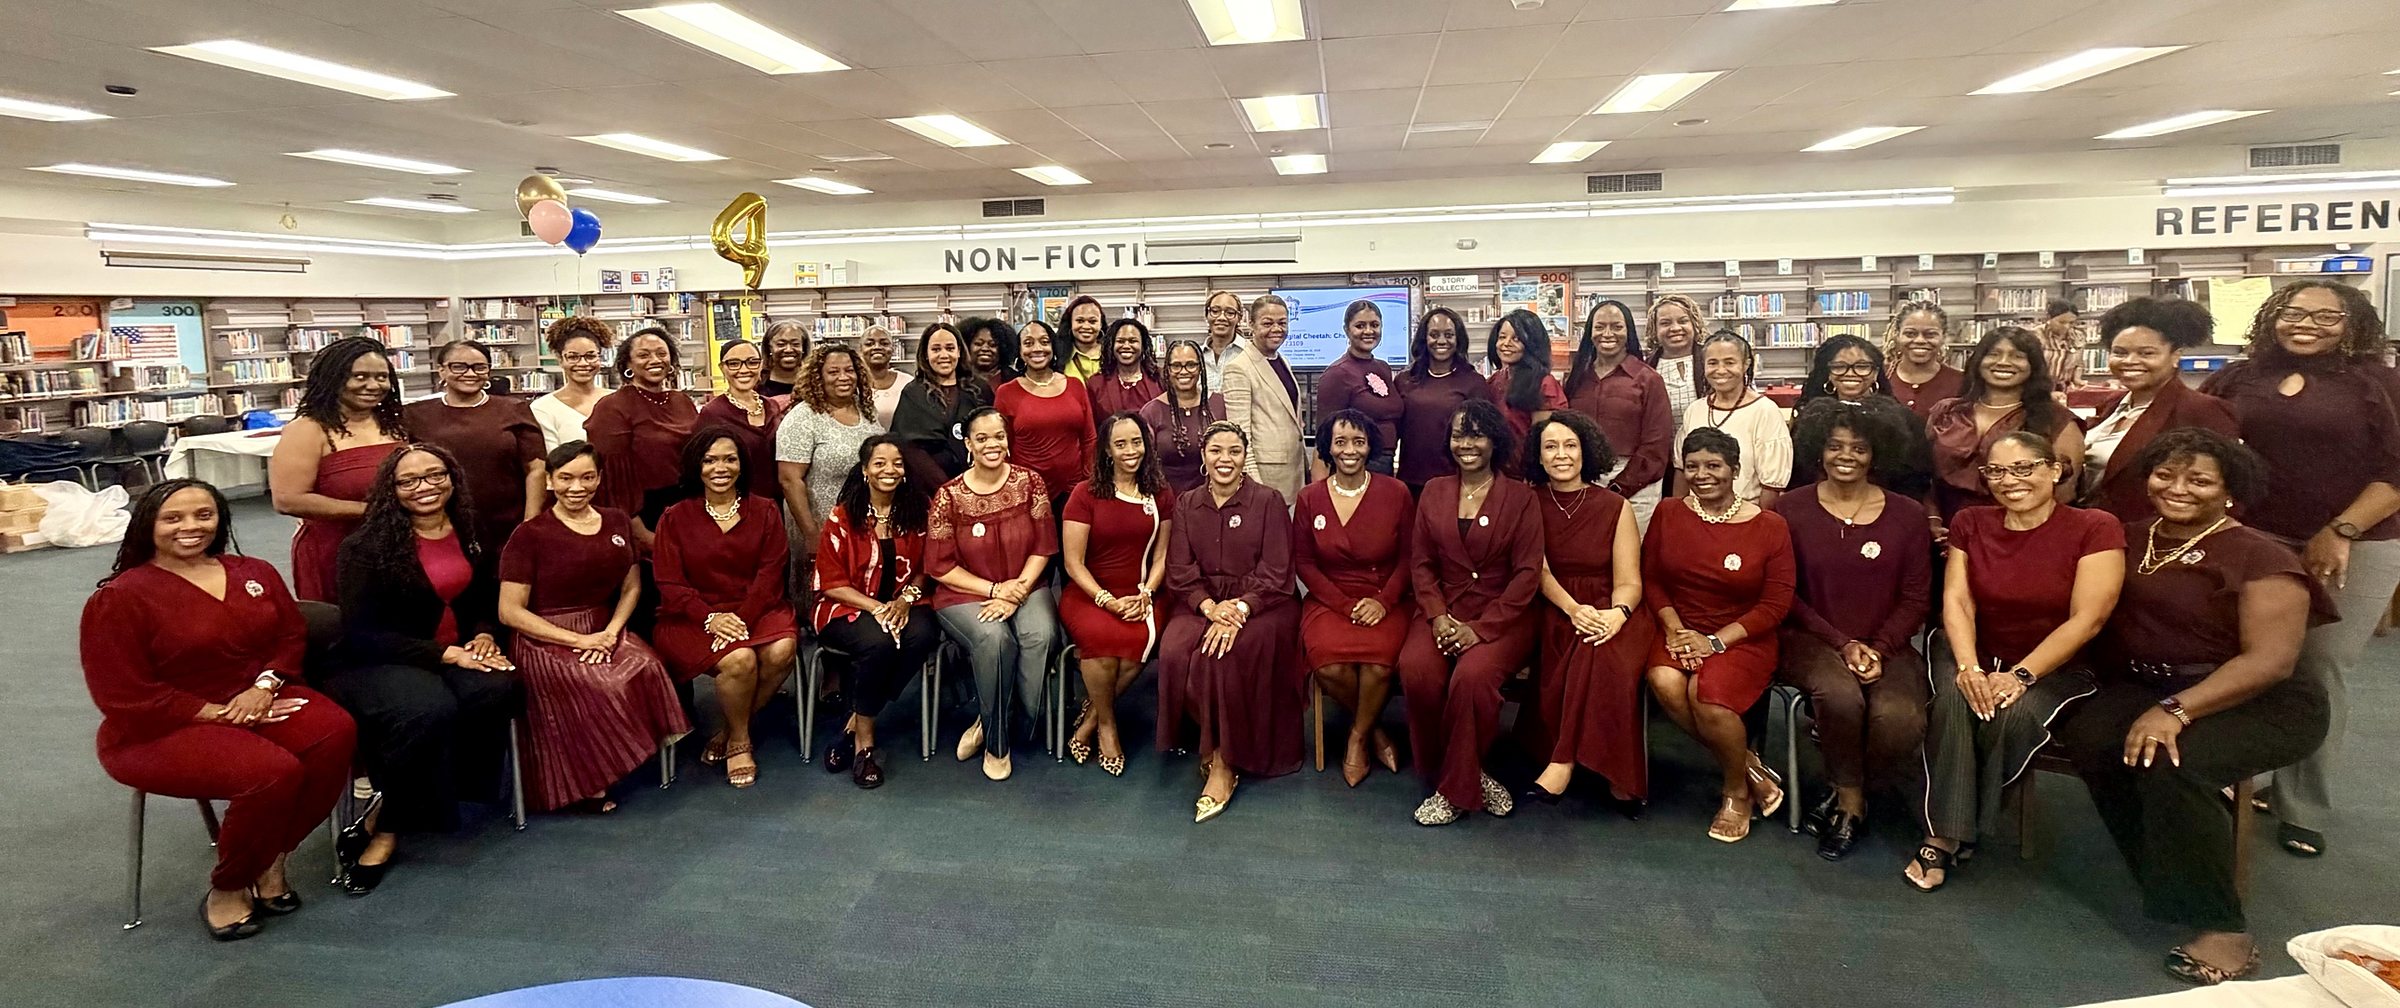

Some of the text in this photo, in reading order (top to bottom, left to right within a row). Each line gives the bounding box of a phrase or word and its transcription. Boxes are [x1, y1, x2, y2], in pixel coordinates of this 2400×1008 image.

[2156, 200, 2400, 236] REFEREN
[945, 243, 1139, 273] NON-FICTI
[1541, 272, 1568, 283] 900
[1046, 288, 1069, 297] 700
[1431, 284, 1477, 292] COLLECTION
[53, 304, 94, 317] 200
[162, 305, 195, 317] 300
